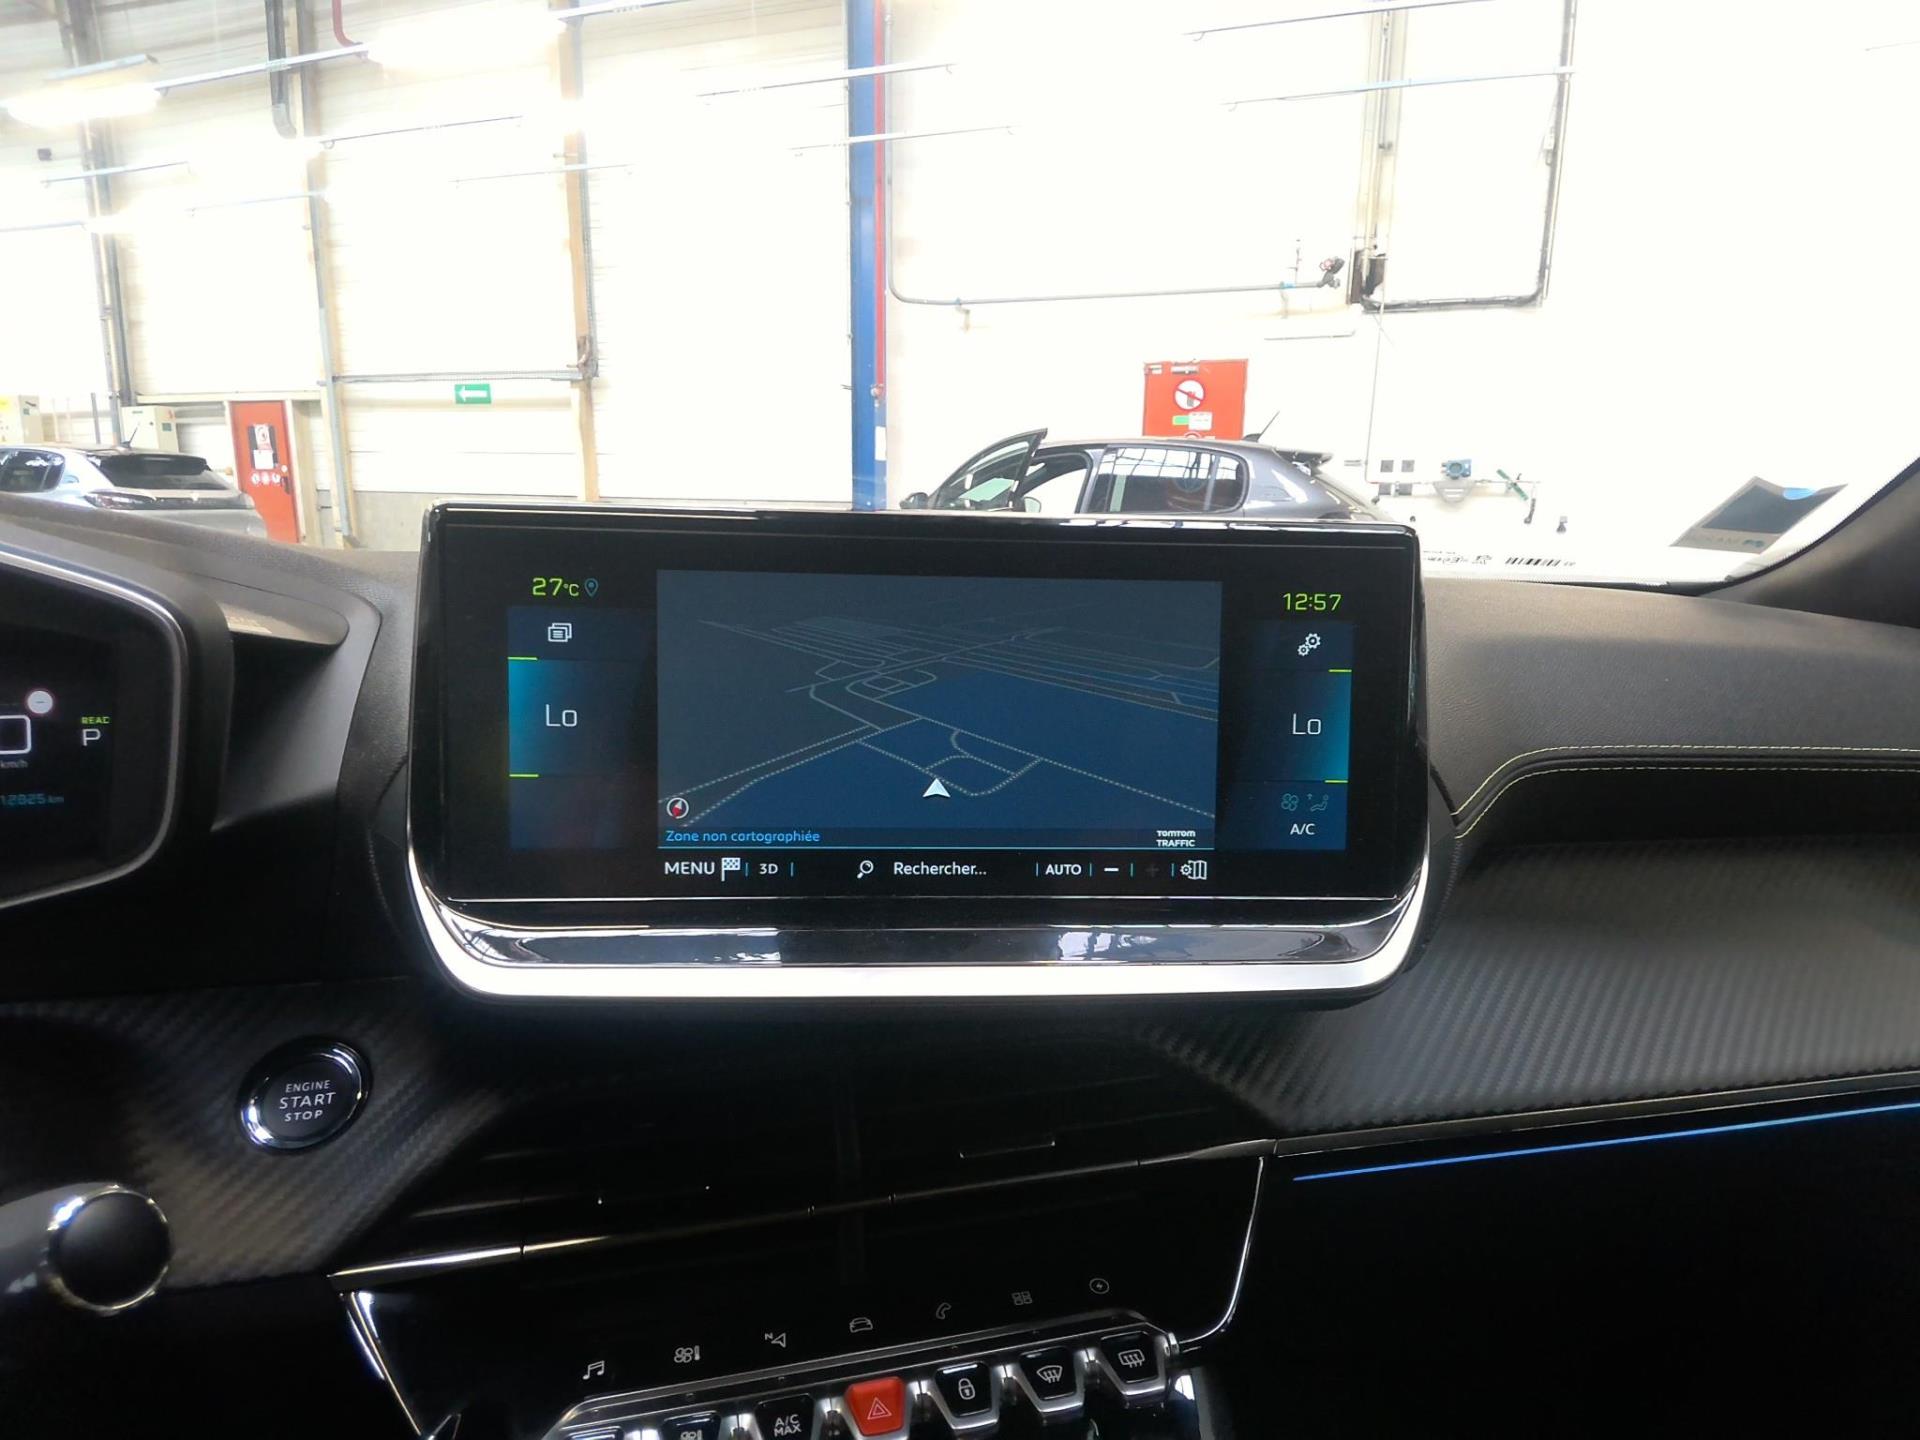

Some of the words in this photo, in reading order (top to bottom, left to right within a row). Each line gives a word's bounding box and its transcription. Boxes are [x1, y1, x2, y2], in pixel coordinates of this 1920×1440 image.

[1282, 593, 1342, 611] 12:57
[545, 703, 578, 727] Lo
[1291, 713, 1322, 735] Lo
[83, 728, 101, 746] P
[665, 830, 700, 842] Zone
[702, 831, 728, 842] non
[730, 829, 821, 844] cartographiée
[1289, 823, 1316, 836] A/C
[1156, 839, 1196, 847] TRAFFIC
[664, 861, 716, 876] MENU
[758, 863, 779, 875] 3D
[1045, 863, 1083, 876] AUTO
[285, 1080, 330, 1093] ENGINE
[279, 1092, 336, 1109] START
[284, 1109, 323, 1122] STOP
[774, 1413, 800, 1427] A/C
[773, 1424, 802, 1438] MAX
